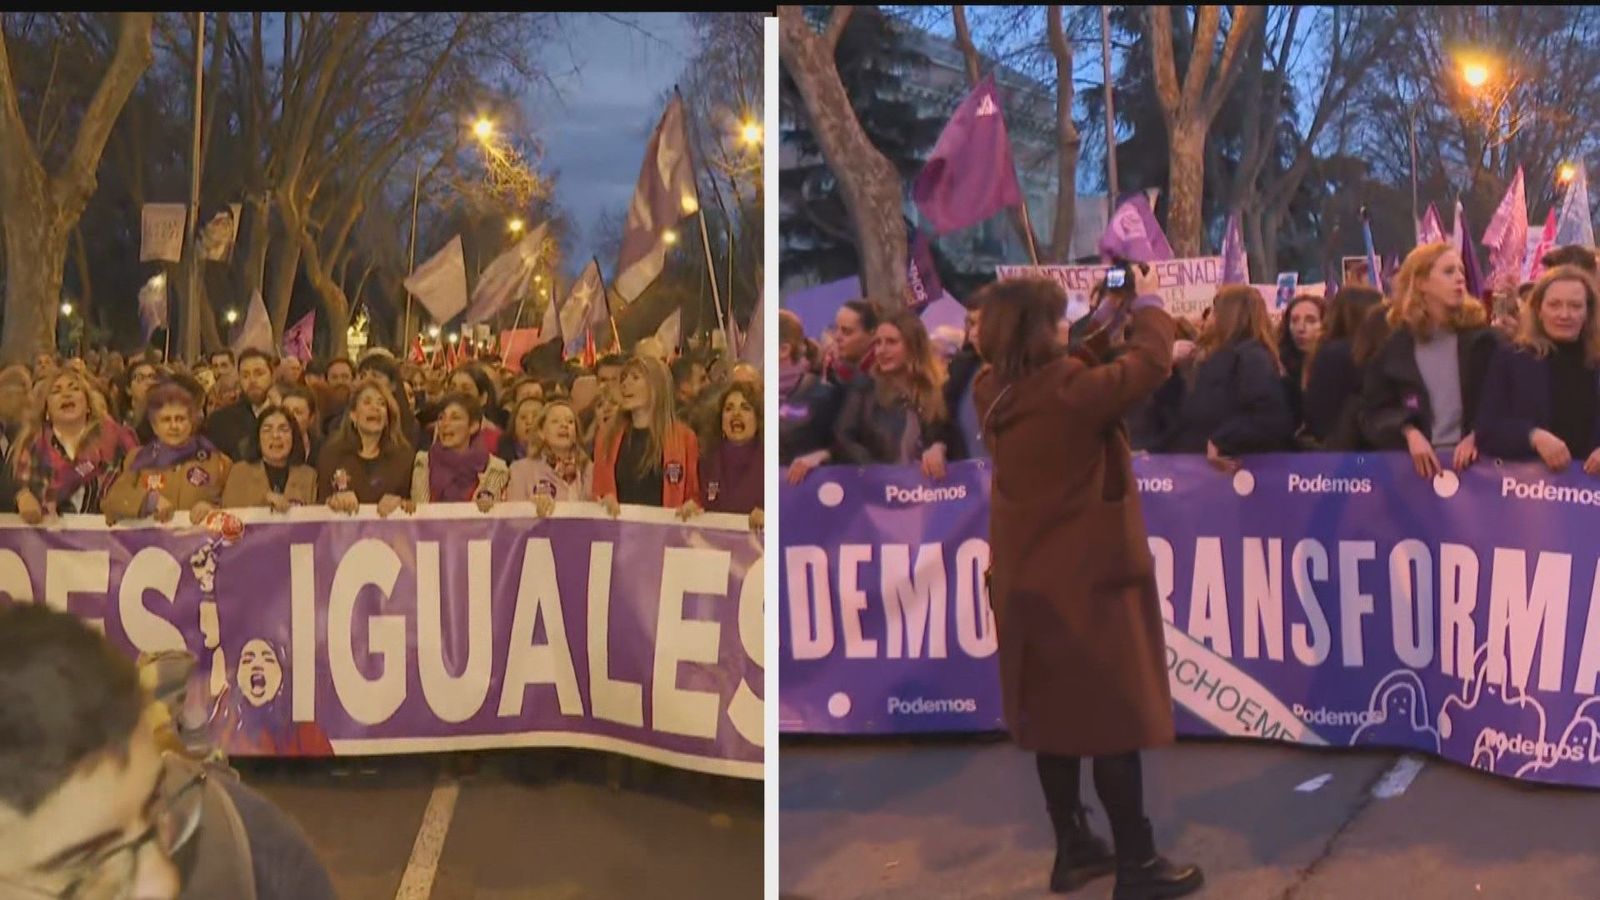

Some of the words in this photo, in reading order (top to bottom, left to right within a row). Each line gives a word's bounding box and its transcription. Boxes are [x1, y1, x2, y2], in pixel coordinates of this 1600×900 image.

[1287, 473, 1372, 493] Podemos
[1502, 476, 1600, 506] Podemos
[885, 484, 967, 502] Podemos
[887, 696, 977, 715] Podemos
